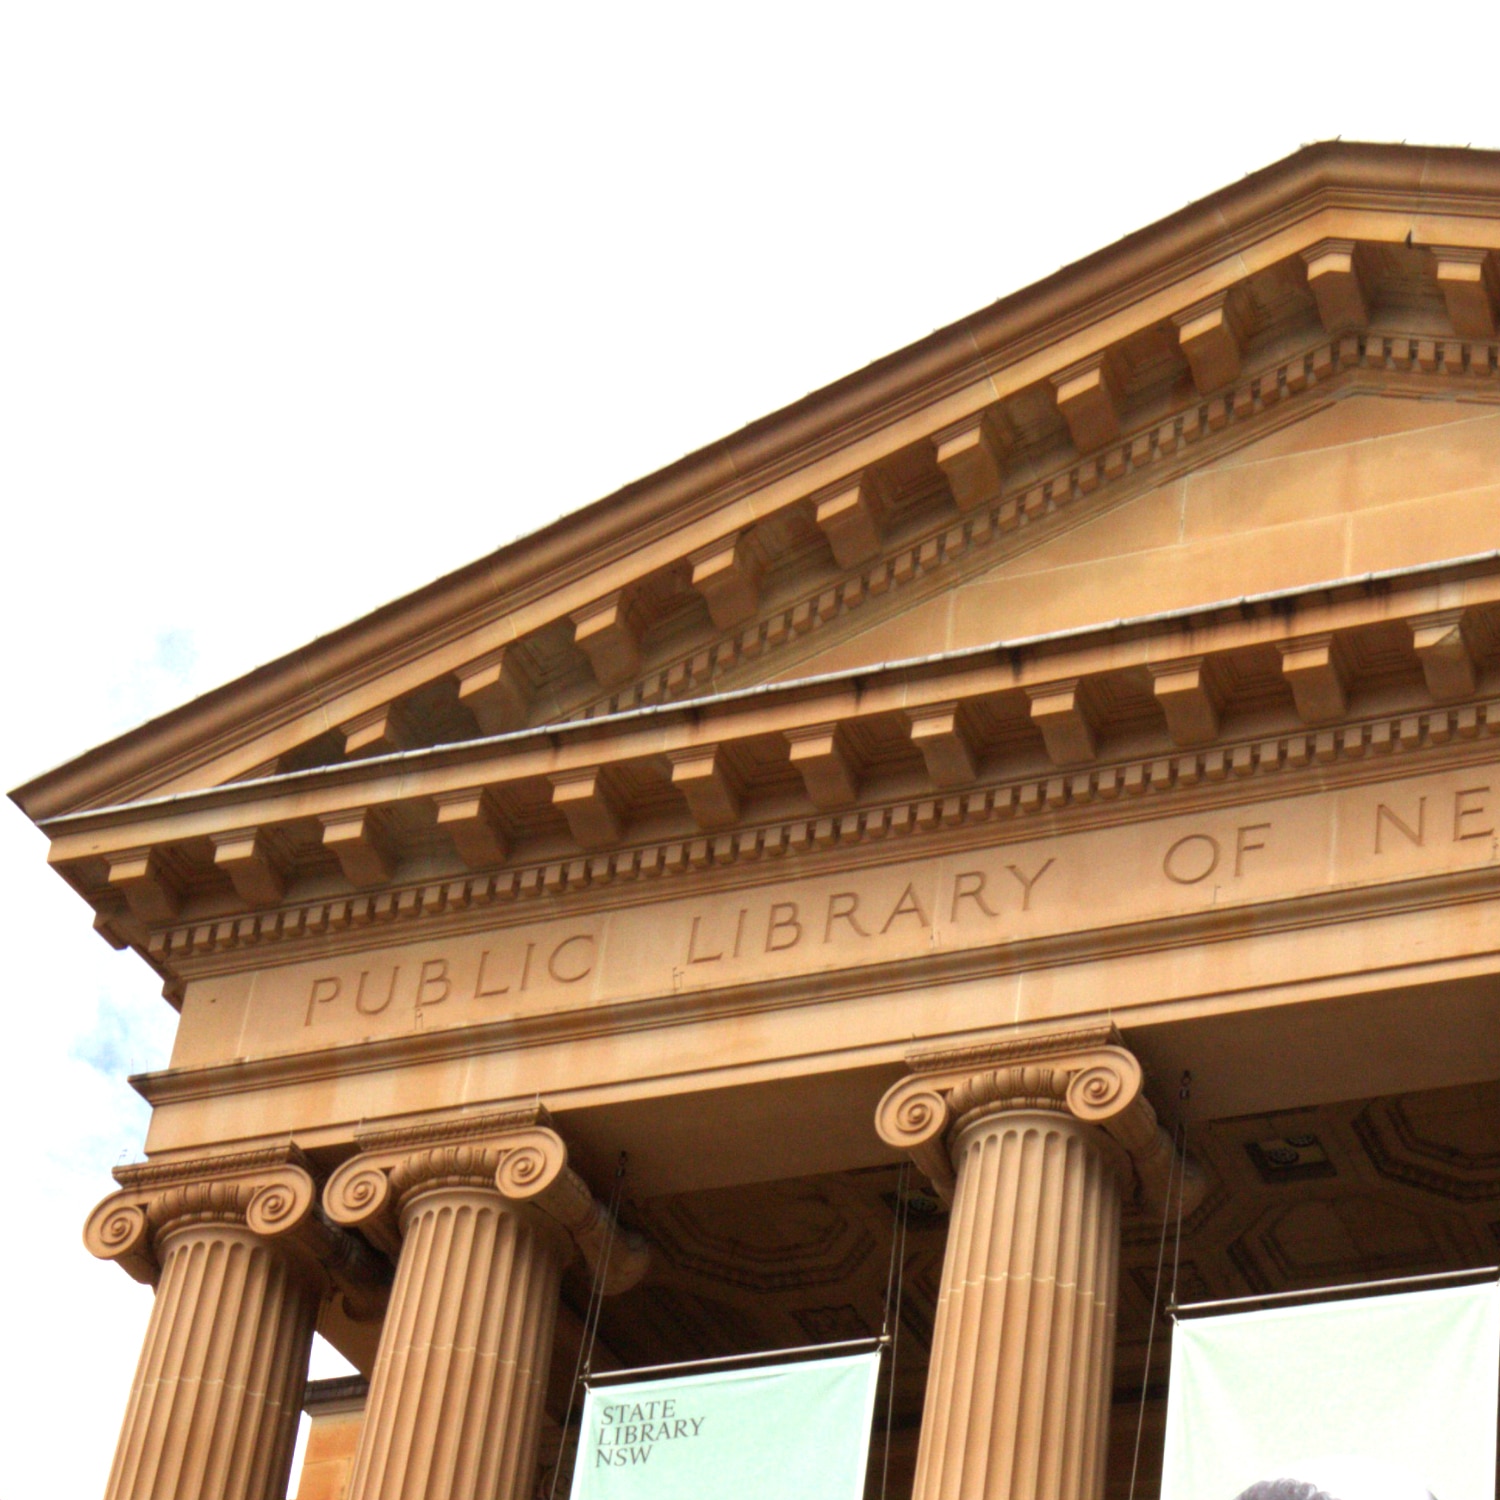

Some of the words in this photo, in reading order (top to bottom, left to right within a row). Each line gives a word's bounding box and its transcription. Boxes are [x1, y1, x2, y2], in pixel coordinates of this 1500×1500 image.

[303, 933, 596, 1027] PUBLIC
[685, 857, 1056, 966] LIBRARY
[1162, 822, 1272, 885] OF
[602, 1400, 675, 1425] STATE
[599, 1417, 704, 1445] LIBRARY
[595, 1446, 652, 1467] NSW
